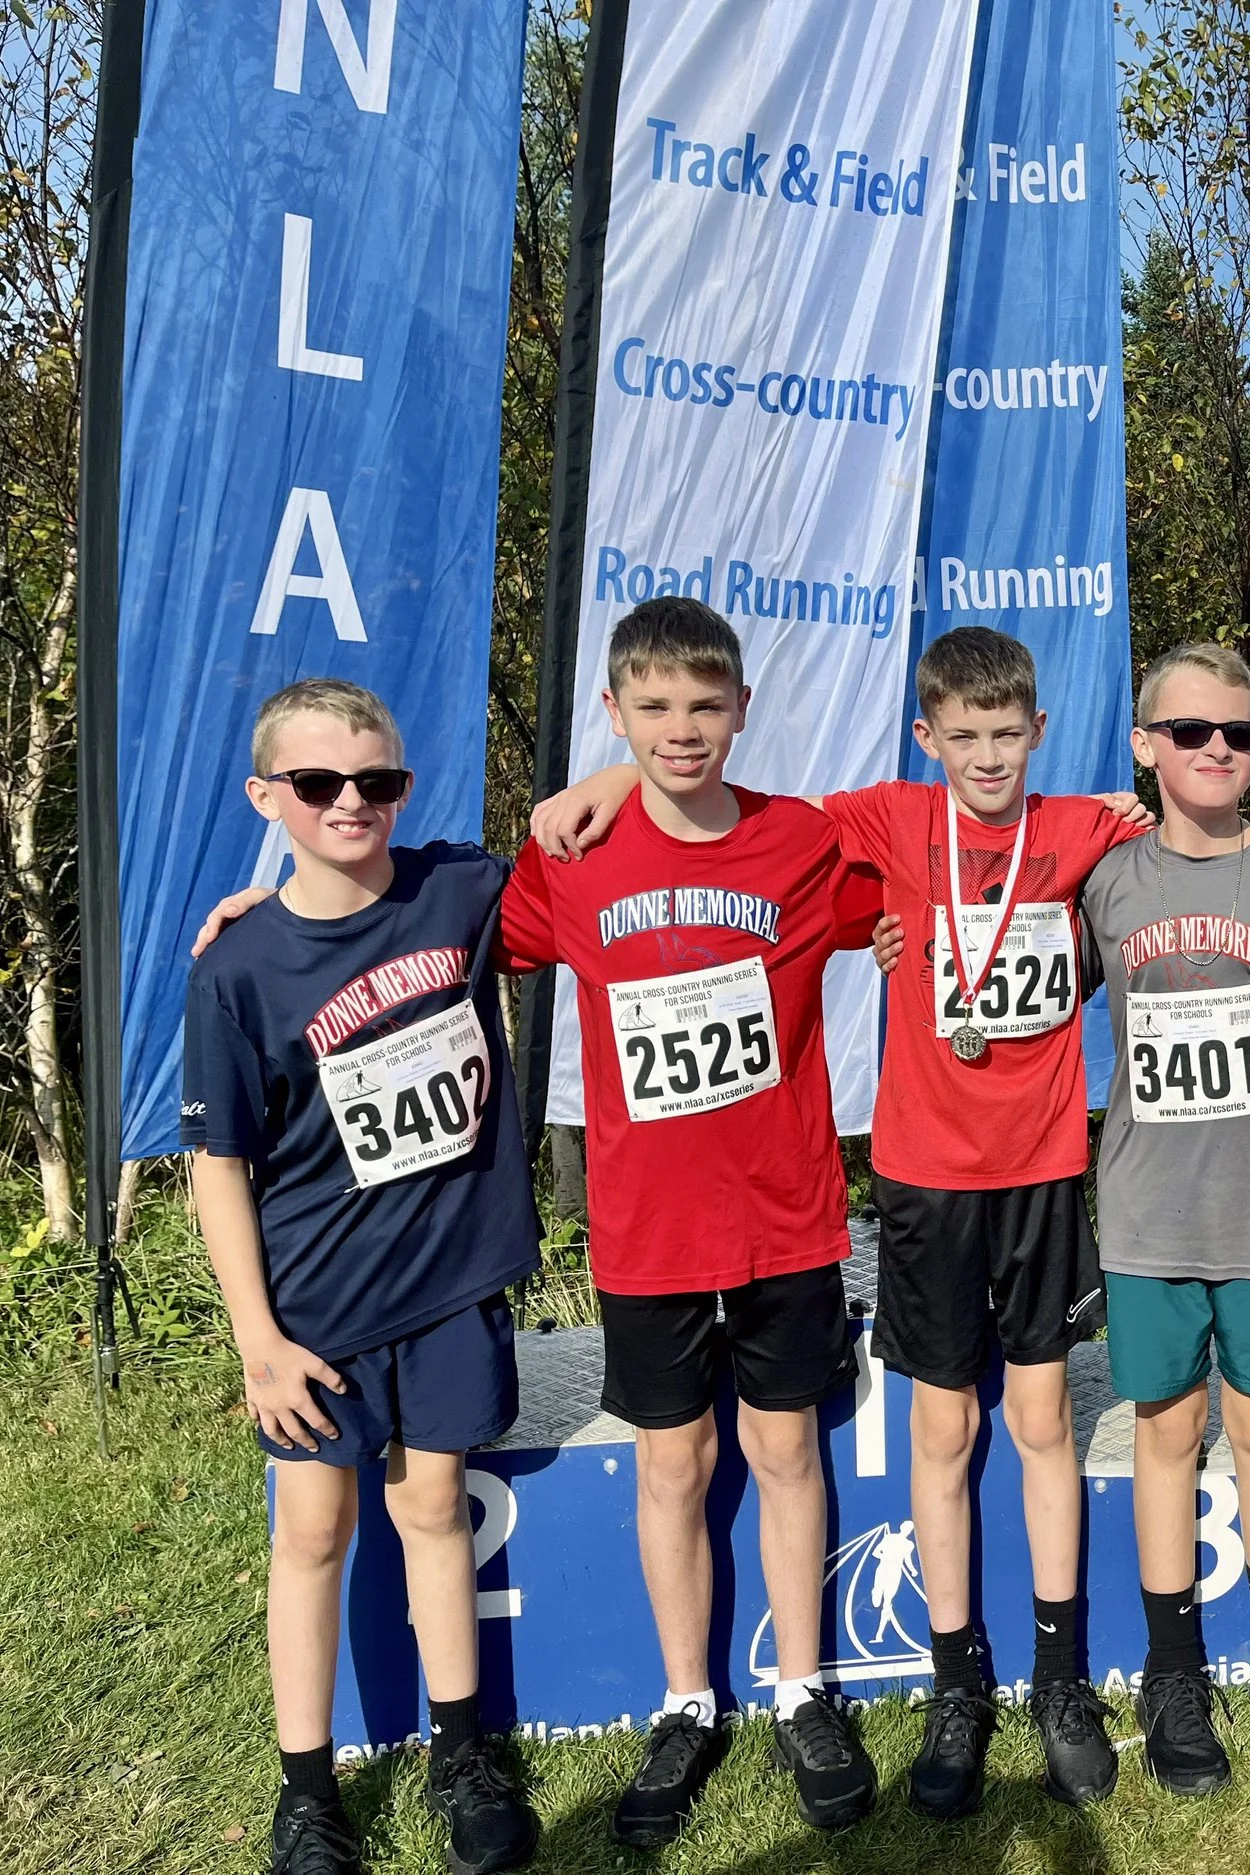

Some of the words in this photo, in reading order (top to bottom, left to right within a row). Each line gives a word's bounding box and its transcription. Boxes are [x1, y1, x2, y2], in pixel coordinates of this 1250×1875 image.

[646, 118, 769, 197] Track
[780, 143, 817, 206] &
[831, 151, 928, 217] Field
[989, 143, 1086, 203] Field
[613, 337, 915, 441] Cross-country
[596, 546, 712, 605] Road
[725, 560, 896, 640] Running
[940, 555, 1113, 617] Running
[599, 888, 670, 947] DUNNE
[673, 888, 781, 944] MEMORIAL
[1007, 923, 1032, 932] CHOOLS
[1121, 919, 1175, 977] DUNNE
[305, 979, 377, 1058] DUNNE
[368, 949, 470, 1009] MEMORIAL
[616, 989, 641, 1002] ANNUAL
[642, 982, 701, 999] CROSS-COUNTRY
[702, 974, 734, 988] RUNNING
[734, 967, 758, 980] SERIES
[664, 996, 679, 1007] FOR
[680, 990, 712, 1005] SCHOOLS
[943, 953, 1072, 1019] 2524
[1131, 1000, 1151, 1010] ANNUAL
[1152, 999, 1203, 1010] CROSS-COUNTRY
[1204, 995, 1233, 1006] RUNNING
[328, 1059, 361, 1076] ANNUAL
[361, 1035, 420, 1066] CROSS-COUNTRY
[420, 1022, 449, 1042] RUNNING
[448, 1010, 469, 1028] SERIES
[1170, 1011, 1183, 1020] FOR
[1184, 1009, 1213, 1020] SCHOOLS
[386, 1055, 401, 1068] FOR
[401, 1041, 432, 1062] SCHOOLS
[625, 1011, 771, 1100] 2525
[344, 1055, 485, 1162] 3402
[660, 1080, 755, 1113] www.nlaa.ca/xcseries
[1159, 1101, 1247, 1118] www.nlaa.ca/xcseries
